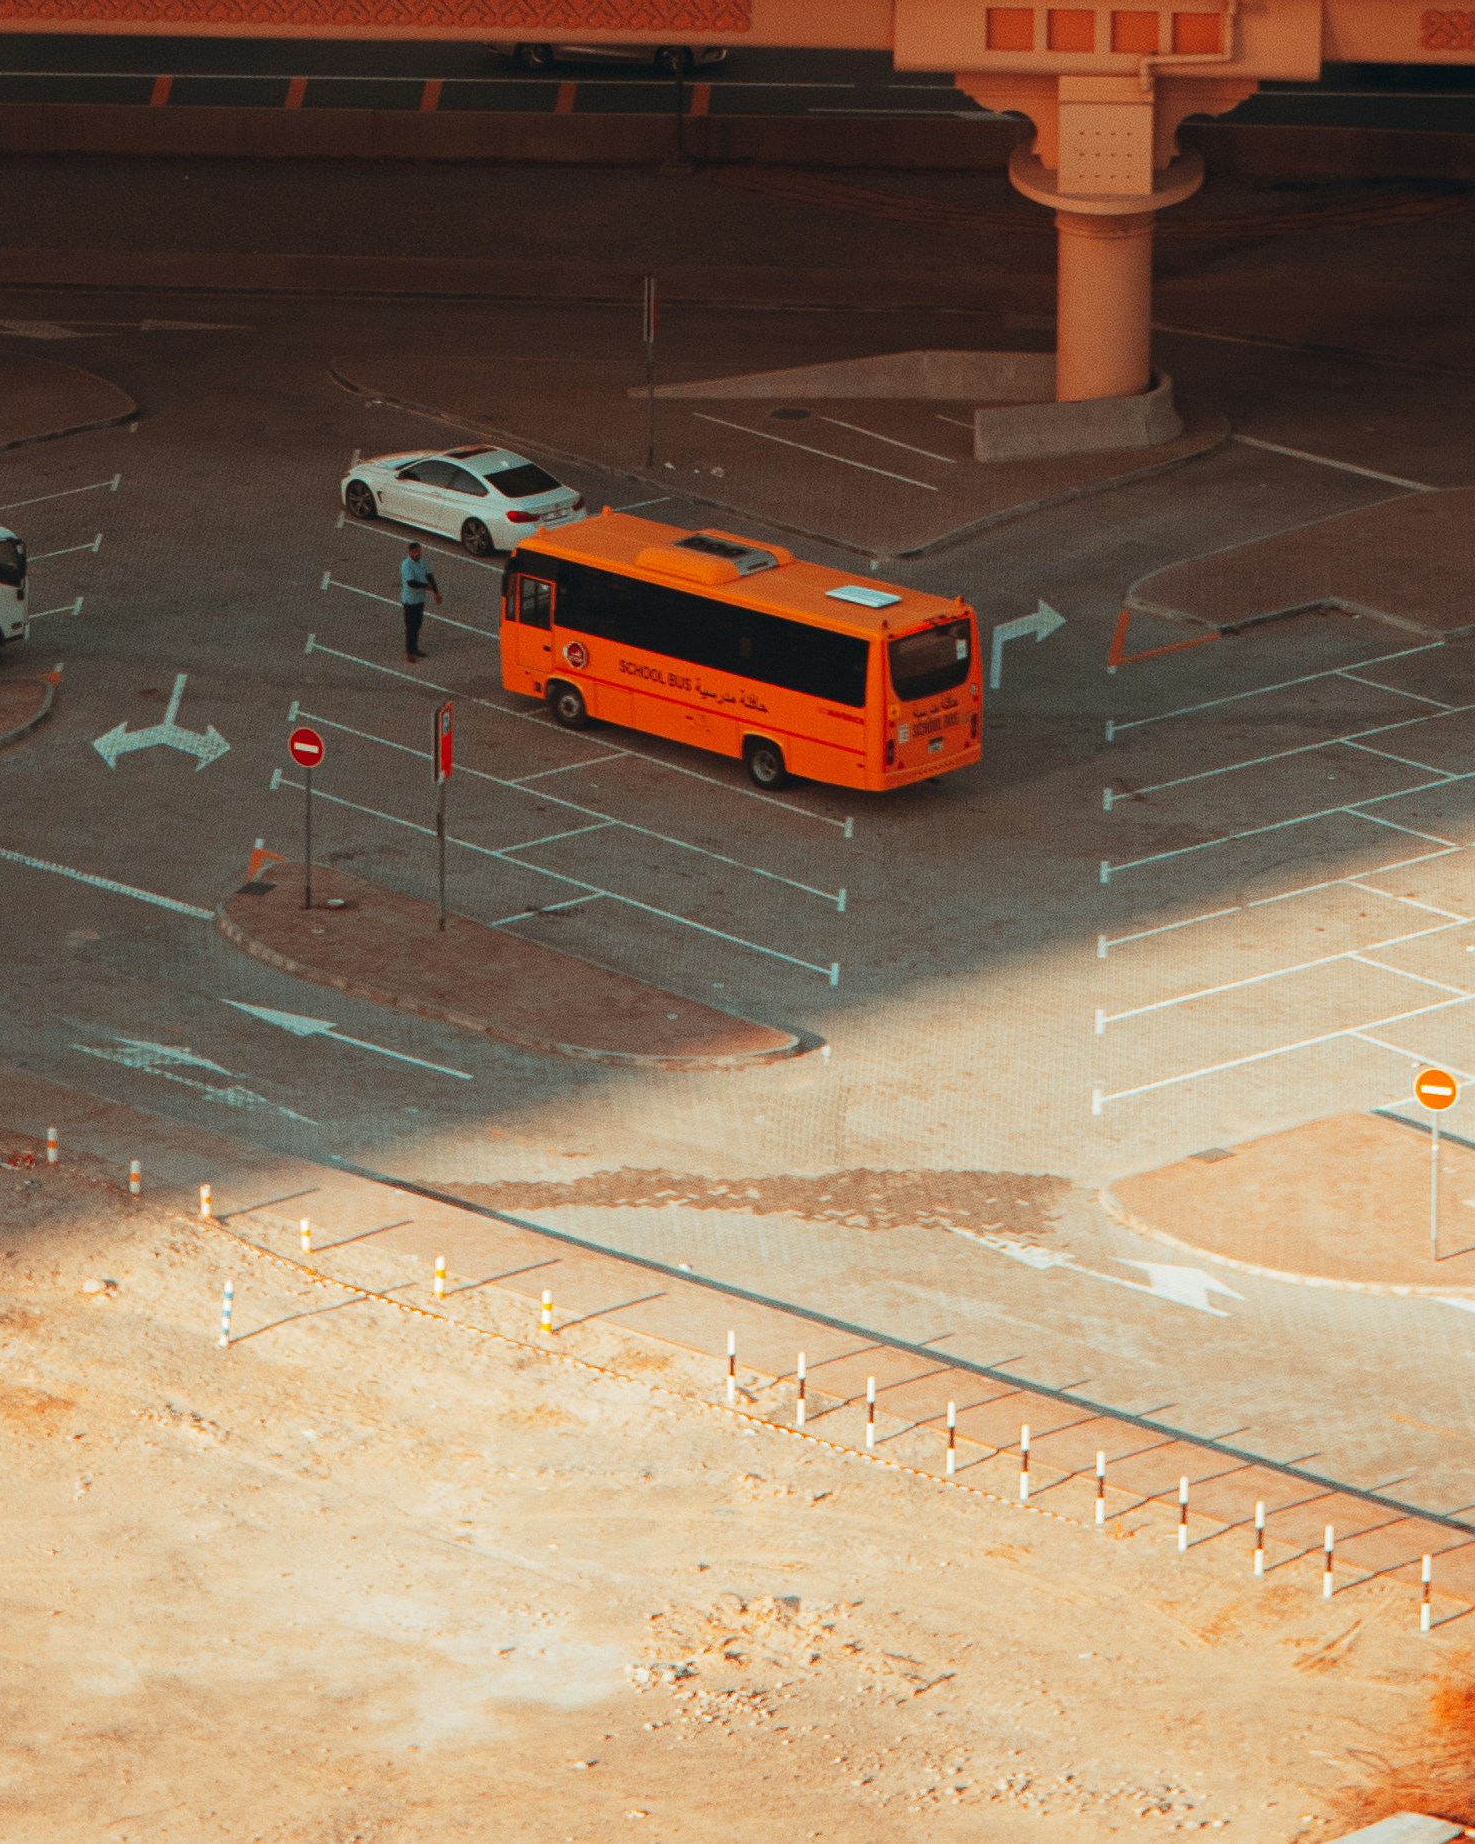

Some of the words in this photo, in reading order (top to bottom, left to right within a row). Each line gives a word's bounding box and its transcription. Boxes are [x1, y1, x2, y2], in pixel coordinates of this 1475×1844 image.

[619, 658, 666, 685] SCHOOL
[668, 672, 692, 692] BUS
[912, 717, 942, 738] SCHOOL
[943, 711, 959, 729] BUS
